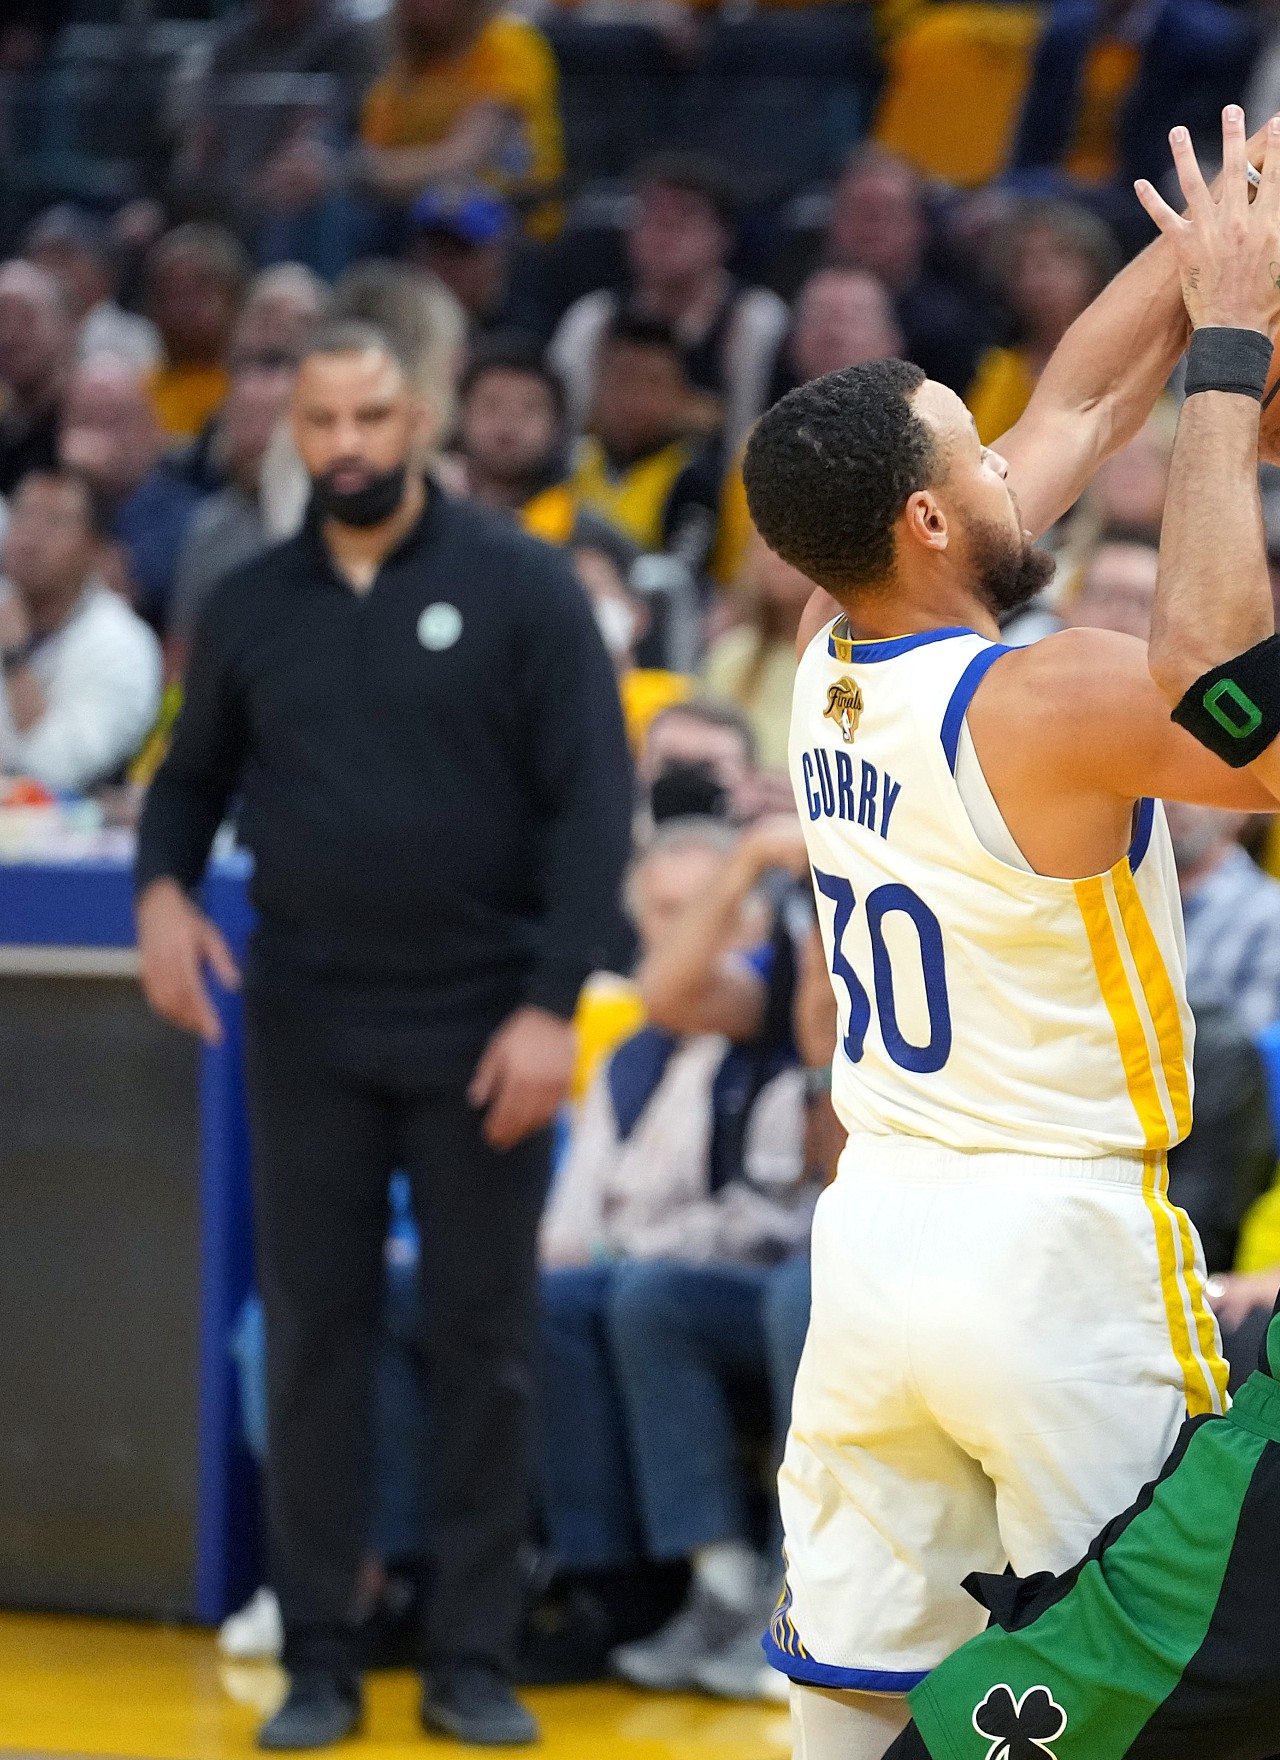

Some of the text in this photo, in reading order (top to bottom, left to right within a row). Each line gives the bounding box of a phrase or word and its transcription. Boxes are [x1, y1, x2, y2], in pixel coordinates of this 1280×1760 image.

[825, 686, 862, 715] Finals
[1203, 678, 1263, 739] 0
[802, 748, 901, 840] CURRY
[812, 864, 952, 1073] 30
